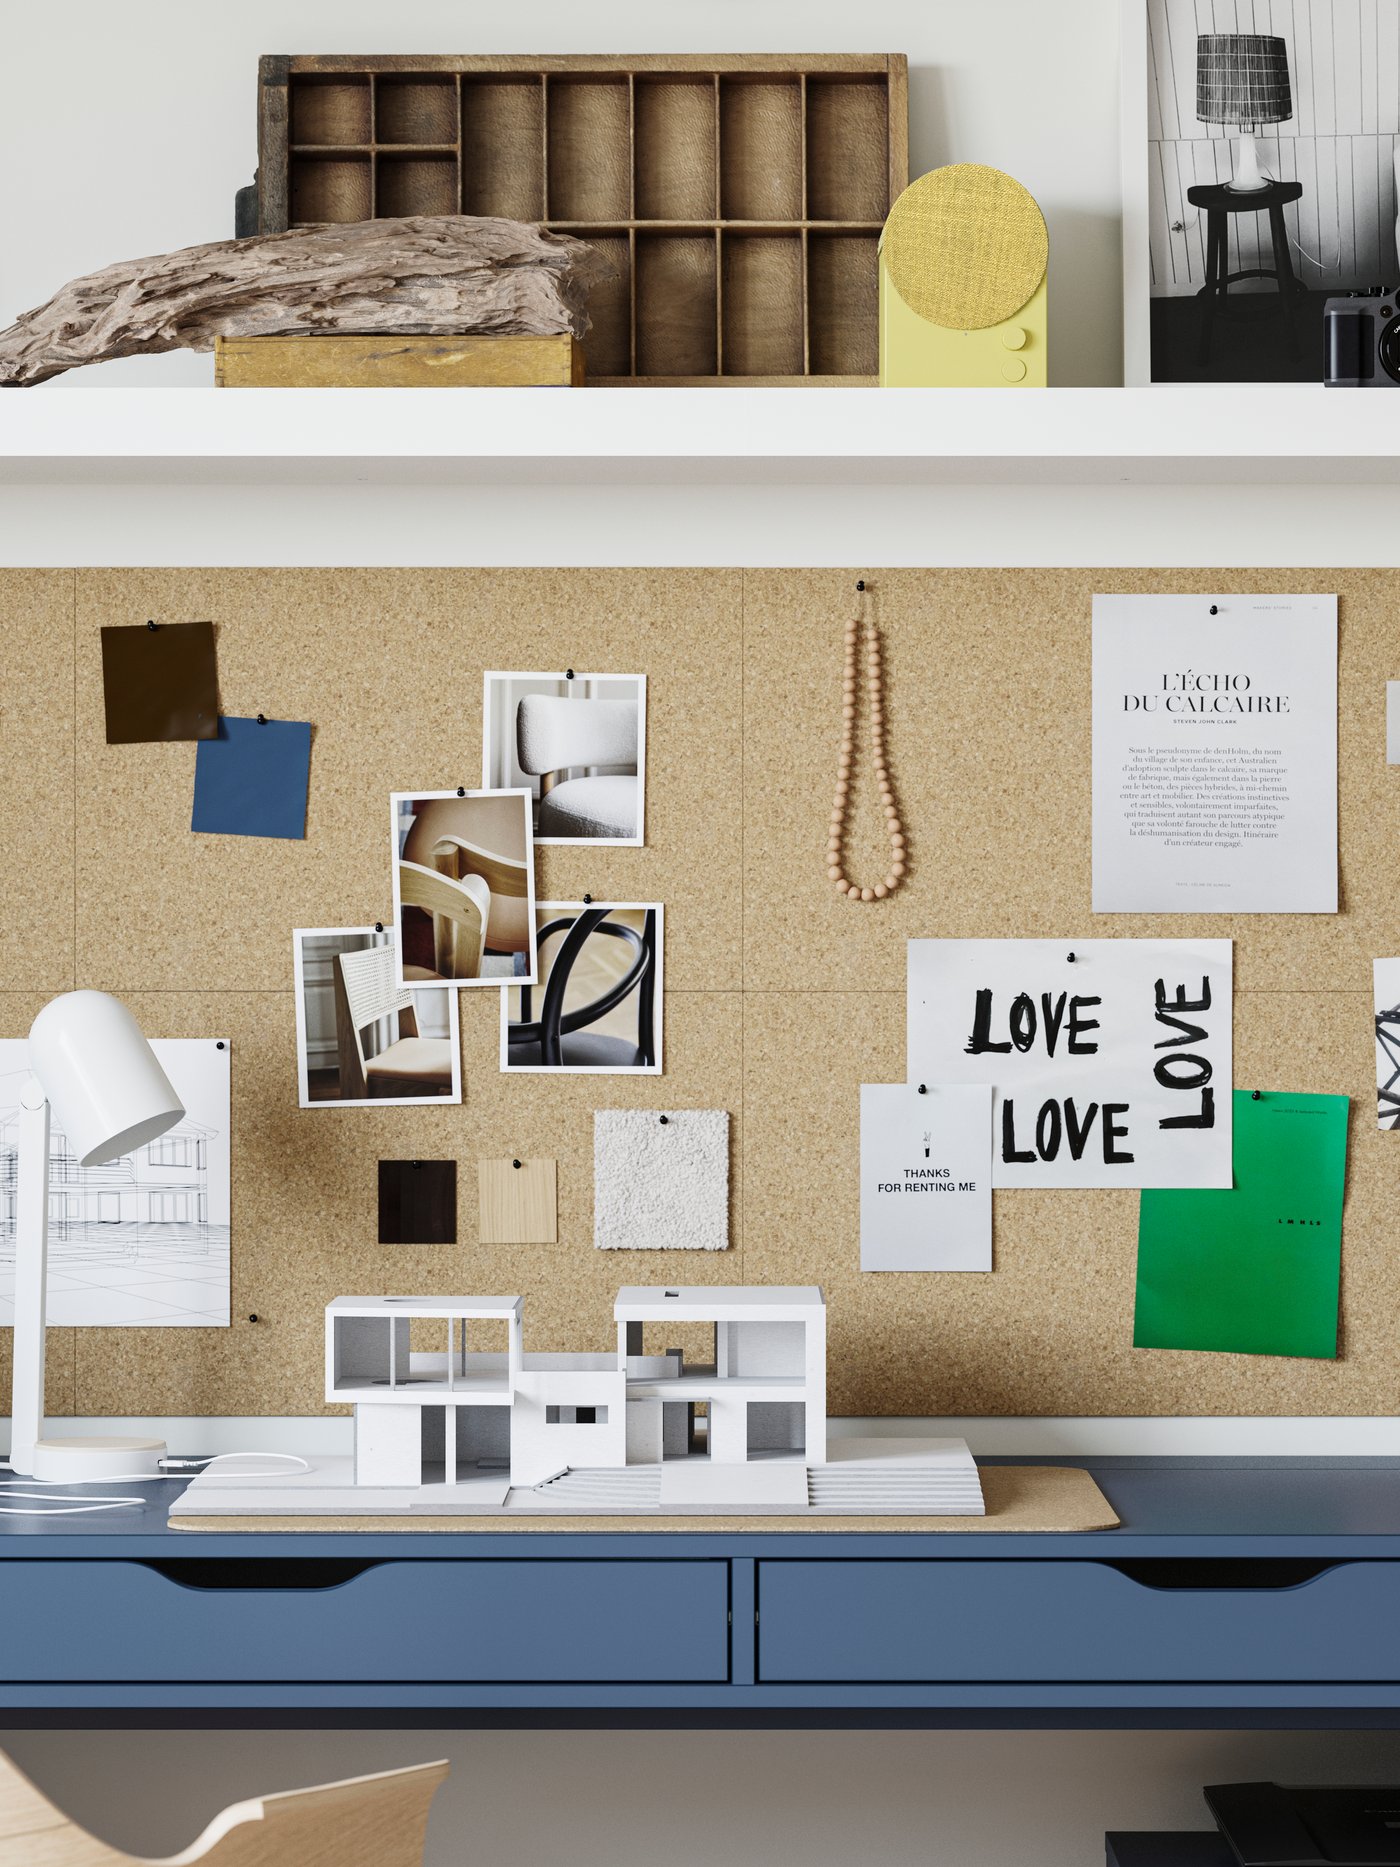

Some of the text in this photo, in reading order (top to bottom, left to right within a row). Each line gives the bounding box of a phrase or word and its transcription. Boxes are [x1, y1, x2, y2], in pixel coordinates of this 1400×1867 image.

[1123, 694, 1290, 713] DU CALCAIRE
[963, 988, 1102, 1058] LOVE
[1153, 976, 1215, 1129] LOVE
[1002, 1097, 1135, 1164] LOVE
[878, 1182, 976, 1193] FOR RENTING ME
[904, 1169, 950, 1178] THANKS
